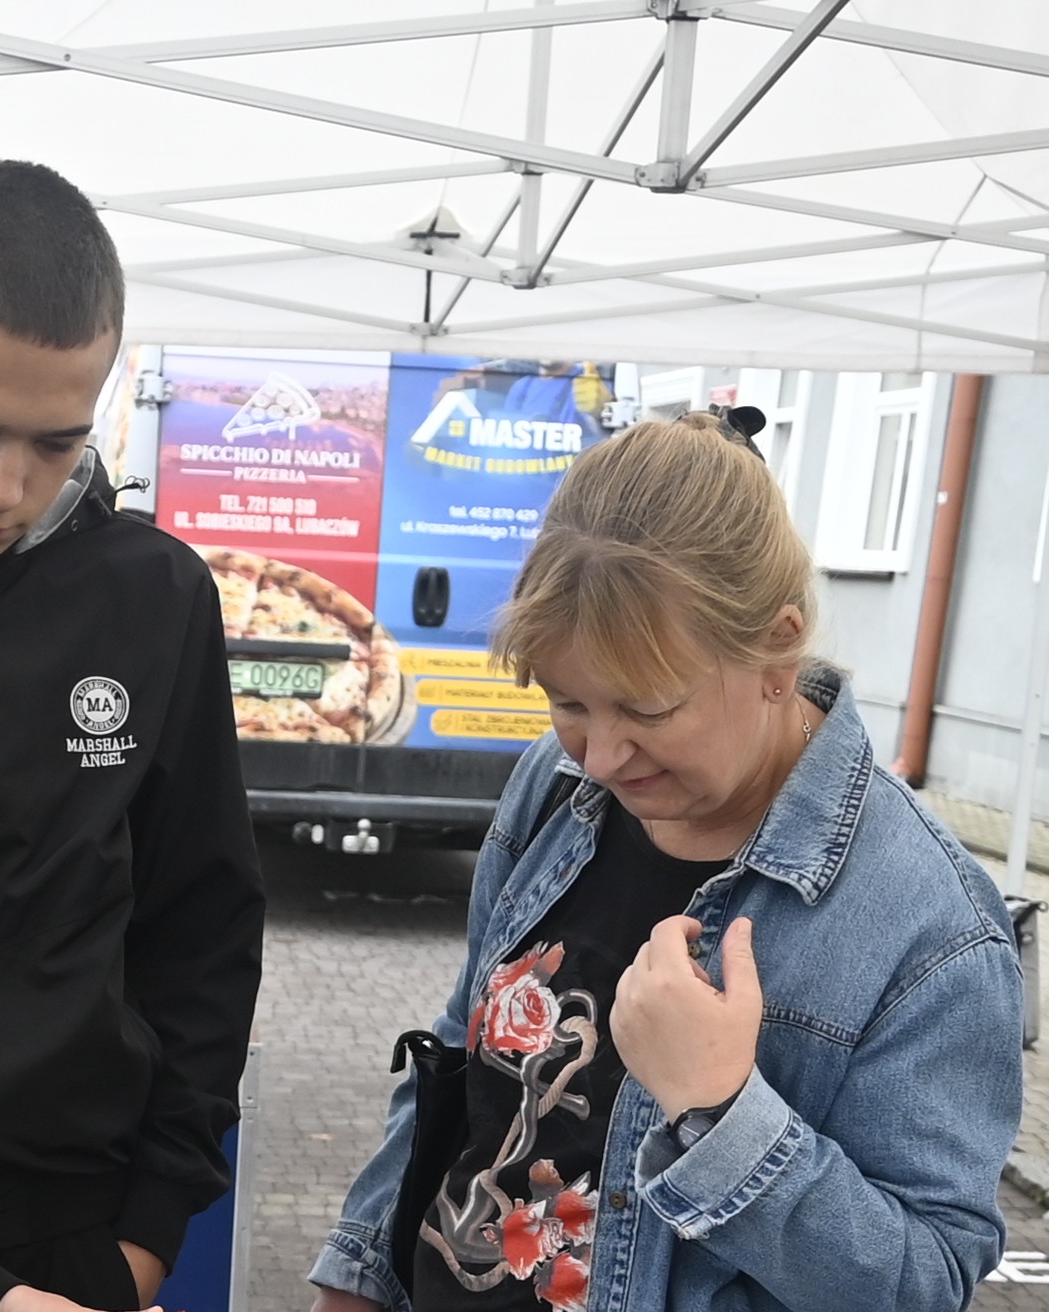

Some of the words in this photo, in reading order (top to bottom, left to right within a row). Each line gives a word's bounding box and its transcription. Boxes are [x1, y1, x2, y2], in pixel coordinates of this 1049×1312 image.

[469, 418, 582, 452] MASTER
[180, 444, 270, 465] SPICCHIO
[271, 447, 292, 465] DI
[294, 449, 360, 468] NAPOLI
[234, 466, 307, 483] PIZZERIA
[250, 663, 319, 689] 0096G
[86, 697, 113, 712] MA
[66, 735, 137, 752] MARSHALL
[80, 752, 126, 767] ANGEL
